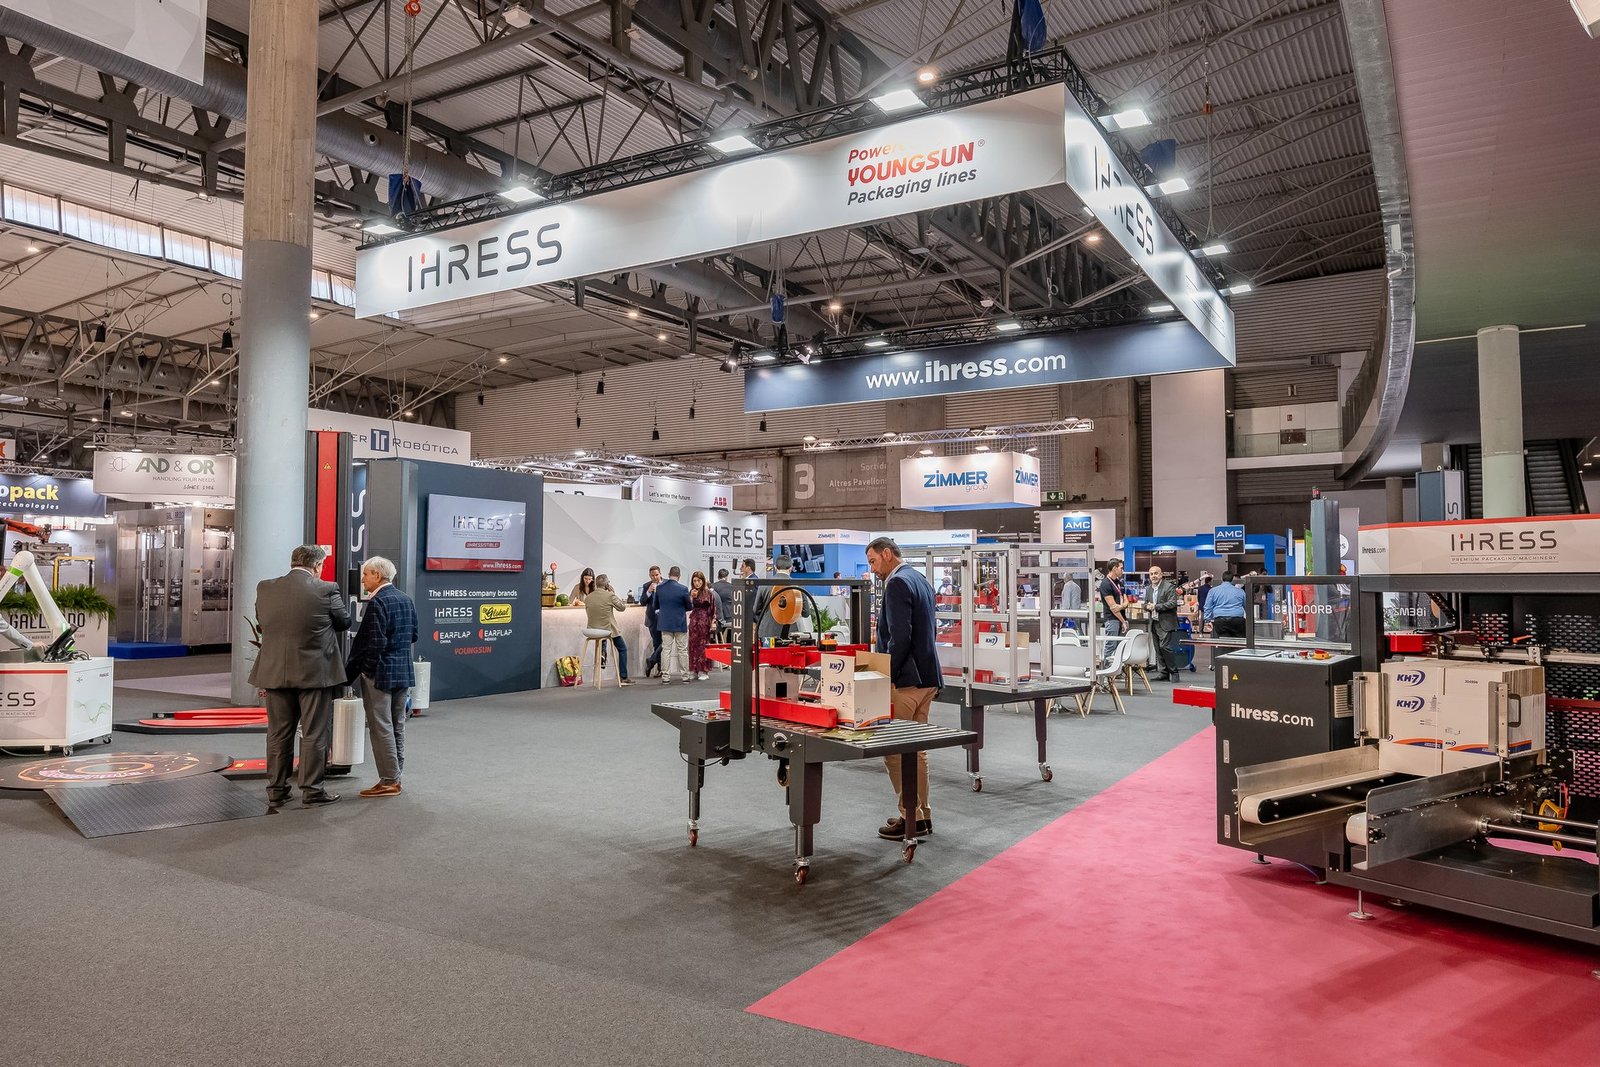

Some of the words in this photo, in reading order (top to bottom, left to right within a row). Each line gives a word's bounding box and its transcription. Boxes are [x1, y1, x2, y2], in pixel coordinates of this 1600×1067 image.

[848, 142, 975, 186] YOUNGSUN
[847, 178, 932, 205] Packaging
[937, 168, 977, 188] lines
[407, 222, 563, 293] IHRESS
[865, 354, 1066, 389] www.ihress.com
[351, 434, 368, 444] ER
[392, 437, 459, 455] ROBÓTICA
[135, 457, 170, 473] AND
[173, 460, 183, 472] &
[187, 459, 215, 475] OR
[860, 462, 886, 471] Sortid
[794, 463, 816, 499] 3
[829, 479, 852, 488] Altres
[853, 477, 886, 486] Pavellon
[965, 484, 988, 493] group
[0, 484, 59, 502] opack
[0, 502, 59, 510] echnologies
[713, 496, 727, 507] ABB
[1065, 521, 1090, 529] AMC
[702, 525, 764, 548] IHRESS
[1216, 530, 1243, 538] AMC
[1451, 530, 1557, 551] IHRESS
[1362, 546, 1386, 554] ihress.com
[434, 607, 473, 617] IHRESS
[1271, 604, 1333, 614] iBE200RB
[10, 613, 86, 629] GALLDO
[733, 590, 742, 663] IHRESS
[440, 631, 471, 639] EARFLAP
[484, 629, 512, 637] EARFLAP
[454, 646, 492, 655] YOUNGSUN
[0, 692, 36, 707] SS
[1230, 703, 1314, 727] ihress.com
